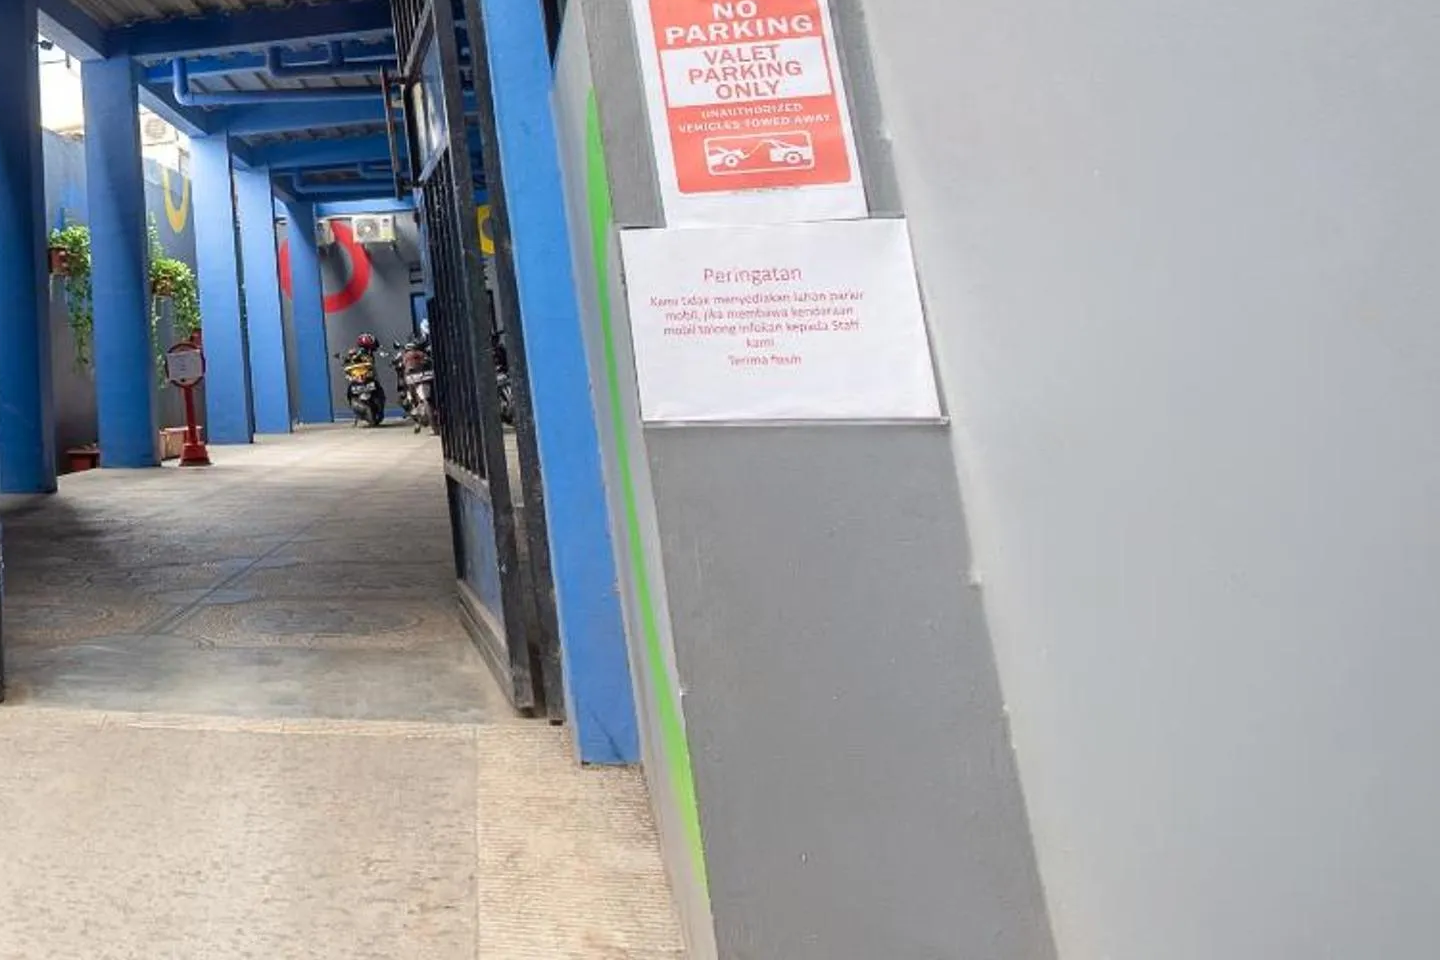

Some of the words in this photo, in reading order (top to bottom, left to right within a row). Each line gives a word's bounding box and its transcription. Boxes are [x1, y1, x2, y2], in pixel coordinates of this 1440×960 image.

[712, 0, 757, 20] NO
[664, 15, 813, 45] PARKING
[703, 44, 781, 66] VALET
[688, 60, 803, 84] PARKING
[715, 80, 781, 100] ONLY
[701, 102, 804, 119] UNAUTHORIZED
[678, 119, 741, 133] VEHICLES
[744, 115, 790, 128] TOWED
[793, 113, 830, 125] AWAY
[704, 266, 803, 285] Peringatan
[650, 295, 679, 306] Kami
[713, 293, 790, 306] menyediakan
[727, 306, 788, 319] membawa
[790, 305, 854, 318] kendaraan
[746, 337, 775, 348] kami
[727, 354, 768, 366] Terima
